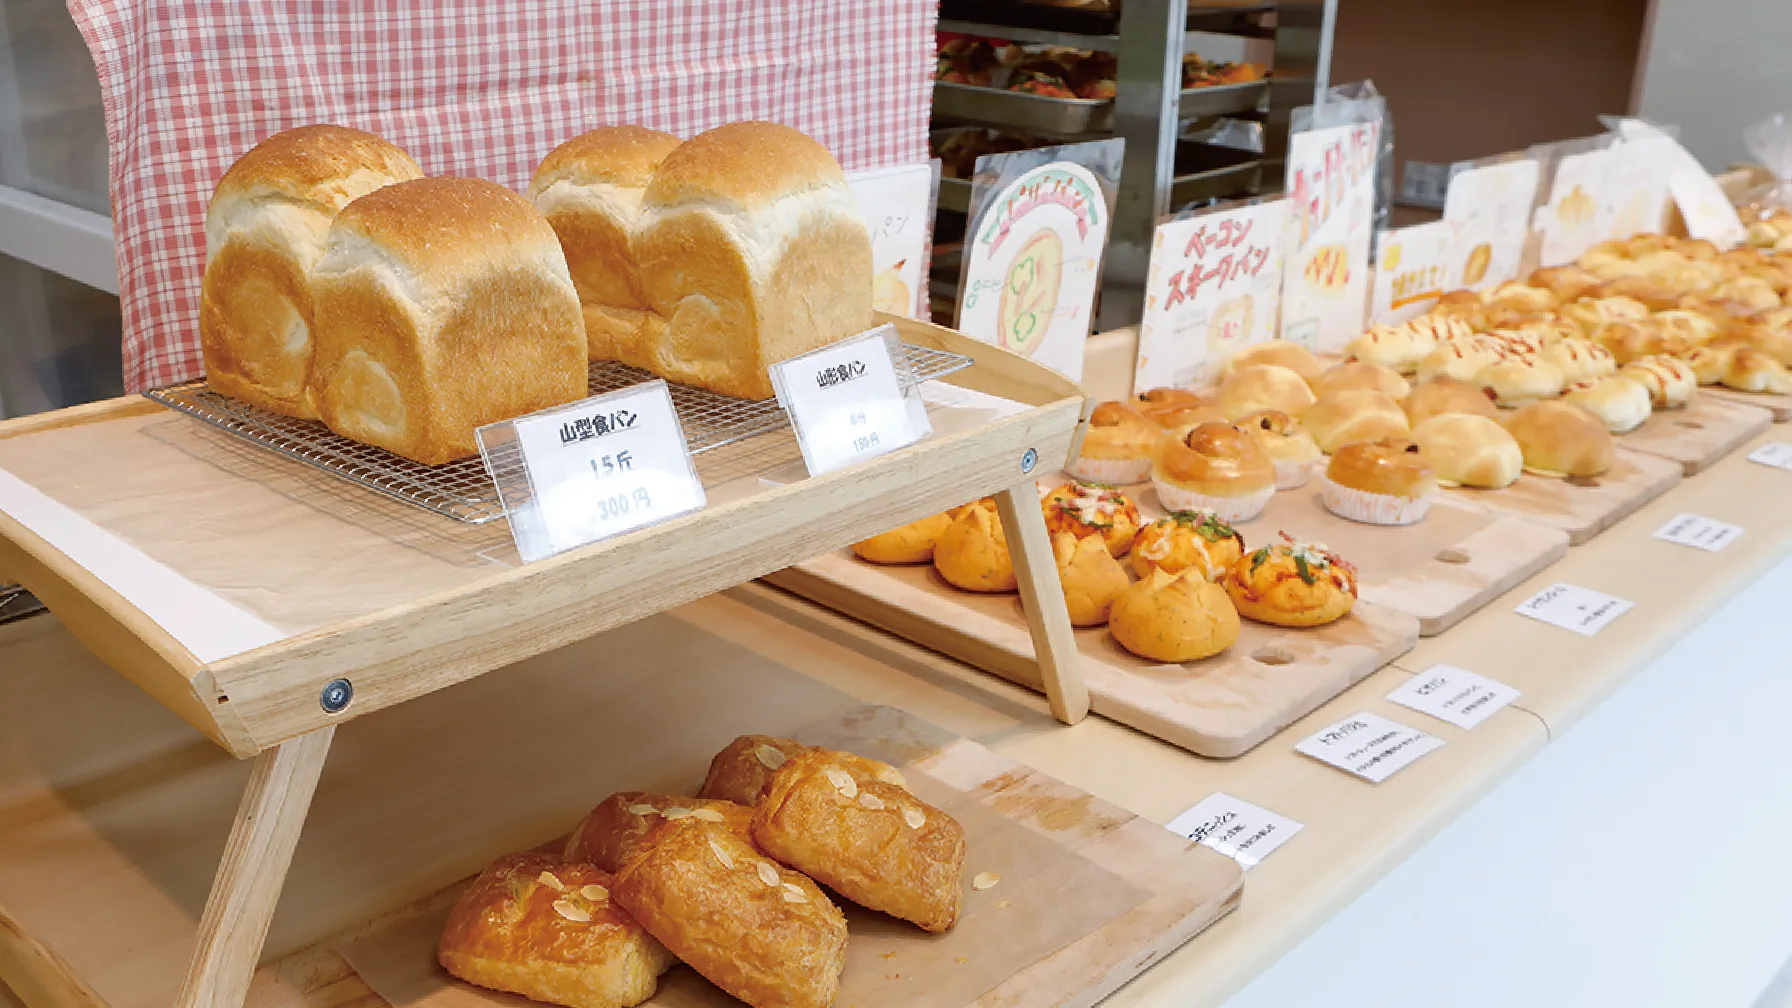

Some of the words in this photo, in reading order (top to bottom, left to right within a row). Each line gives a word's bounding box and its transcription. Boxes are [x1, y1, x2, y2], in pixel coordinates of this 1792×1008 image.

[1184, 218, 1253, 259] ベーコン
[815, 360, 867, 388] 山形食パン
[559, 409, 638, 444] 山型食パン
[597, 486, 652, 520] 300円
